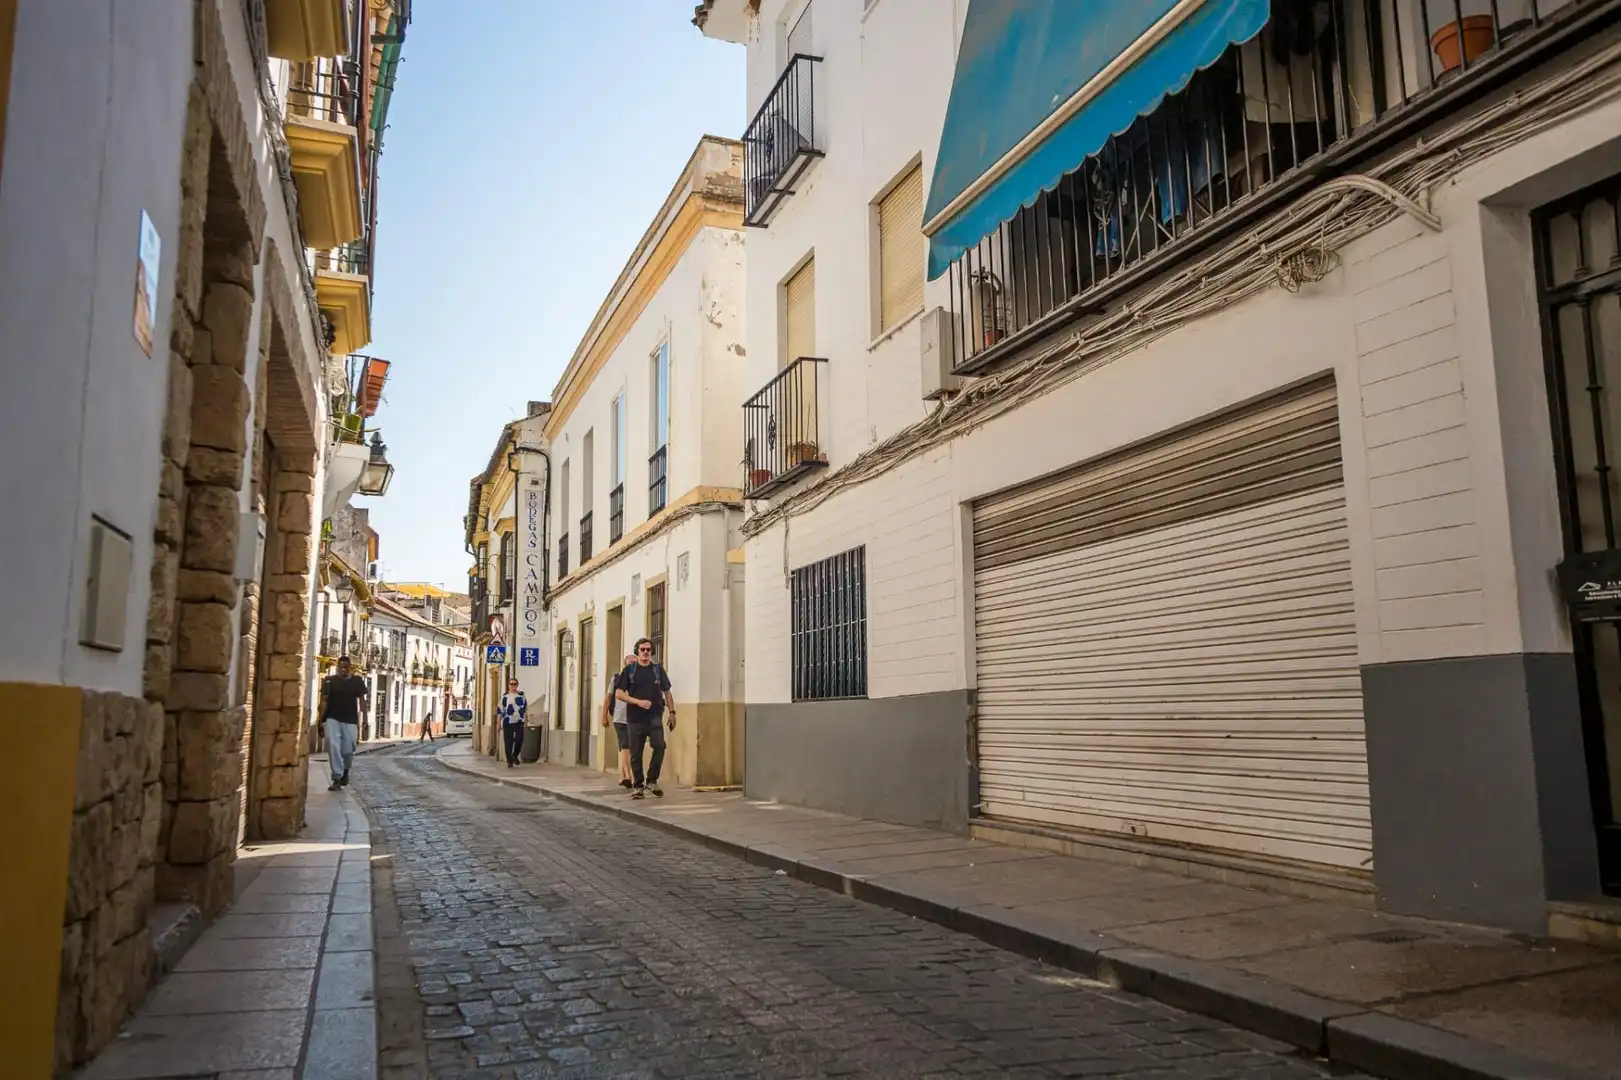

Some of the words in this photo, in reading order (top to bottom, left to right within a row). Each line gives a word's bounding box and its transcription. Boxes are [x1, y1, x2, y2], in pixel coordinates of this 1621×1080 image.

[528, 491, 538, 548] BODEGAS
[524, 553, 539, 637] CAMPOS
[525, 649, 536, 659] R
